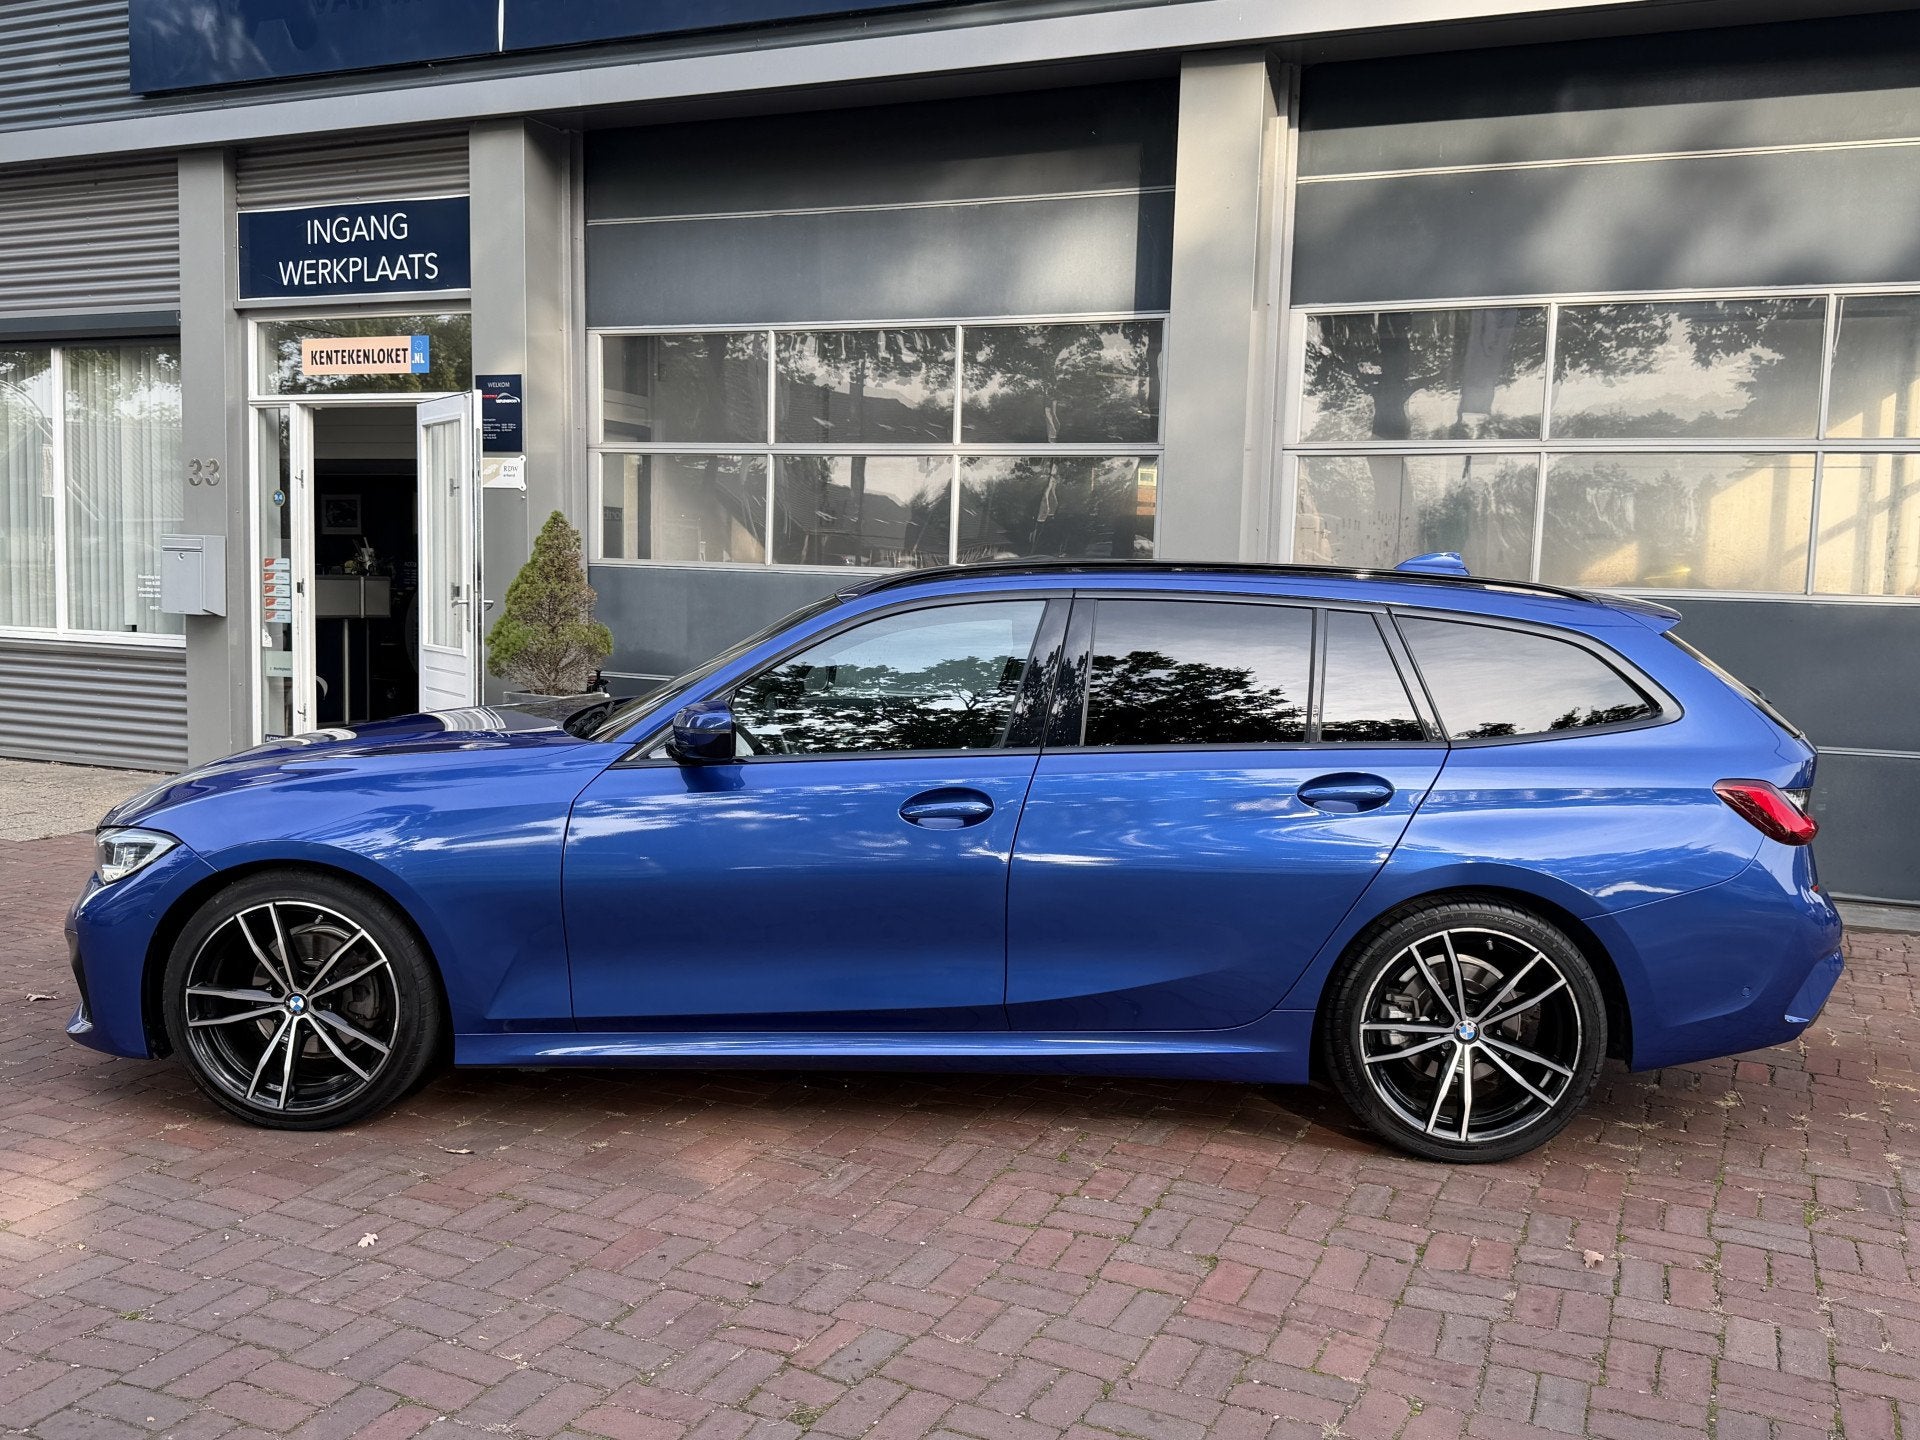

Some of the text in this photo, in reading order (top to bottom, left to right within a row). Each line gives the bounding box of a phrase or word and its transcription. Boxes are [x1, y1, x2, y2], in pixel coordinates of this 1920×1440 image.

[307, 212, 409, 245] INGANG
[278, 252, 439, 286] WERKPLAATS
[310, 347, 409, 366] KENTEKENLOKET
[188, 457, 220, 487] 33
